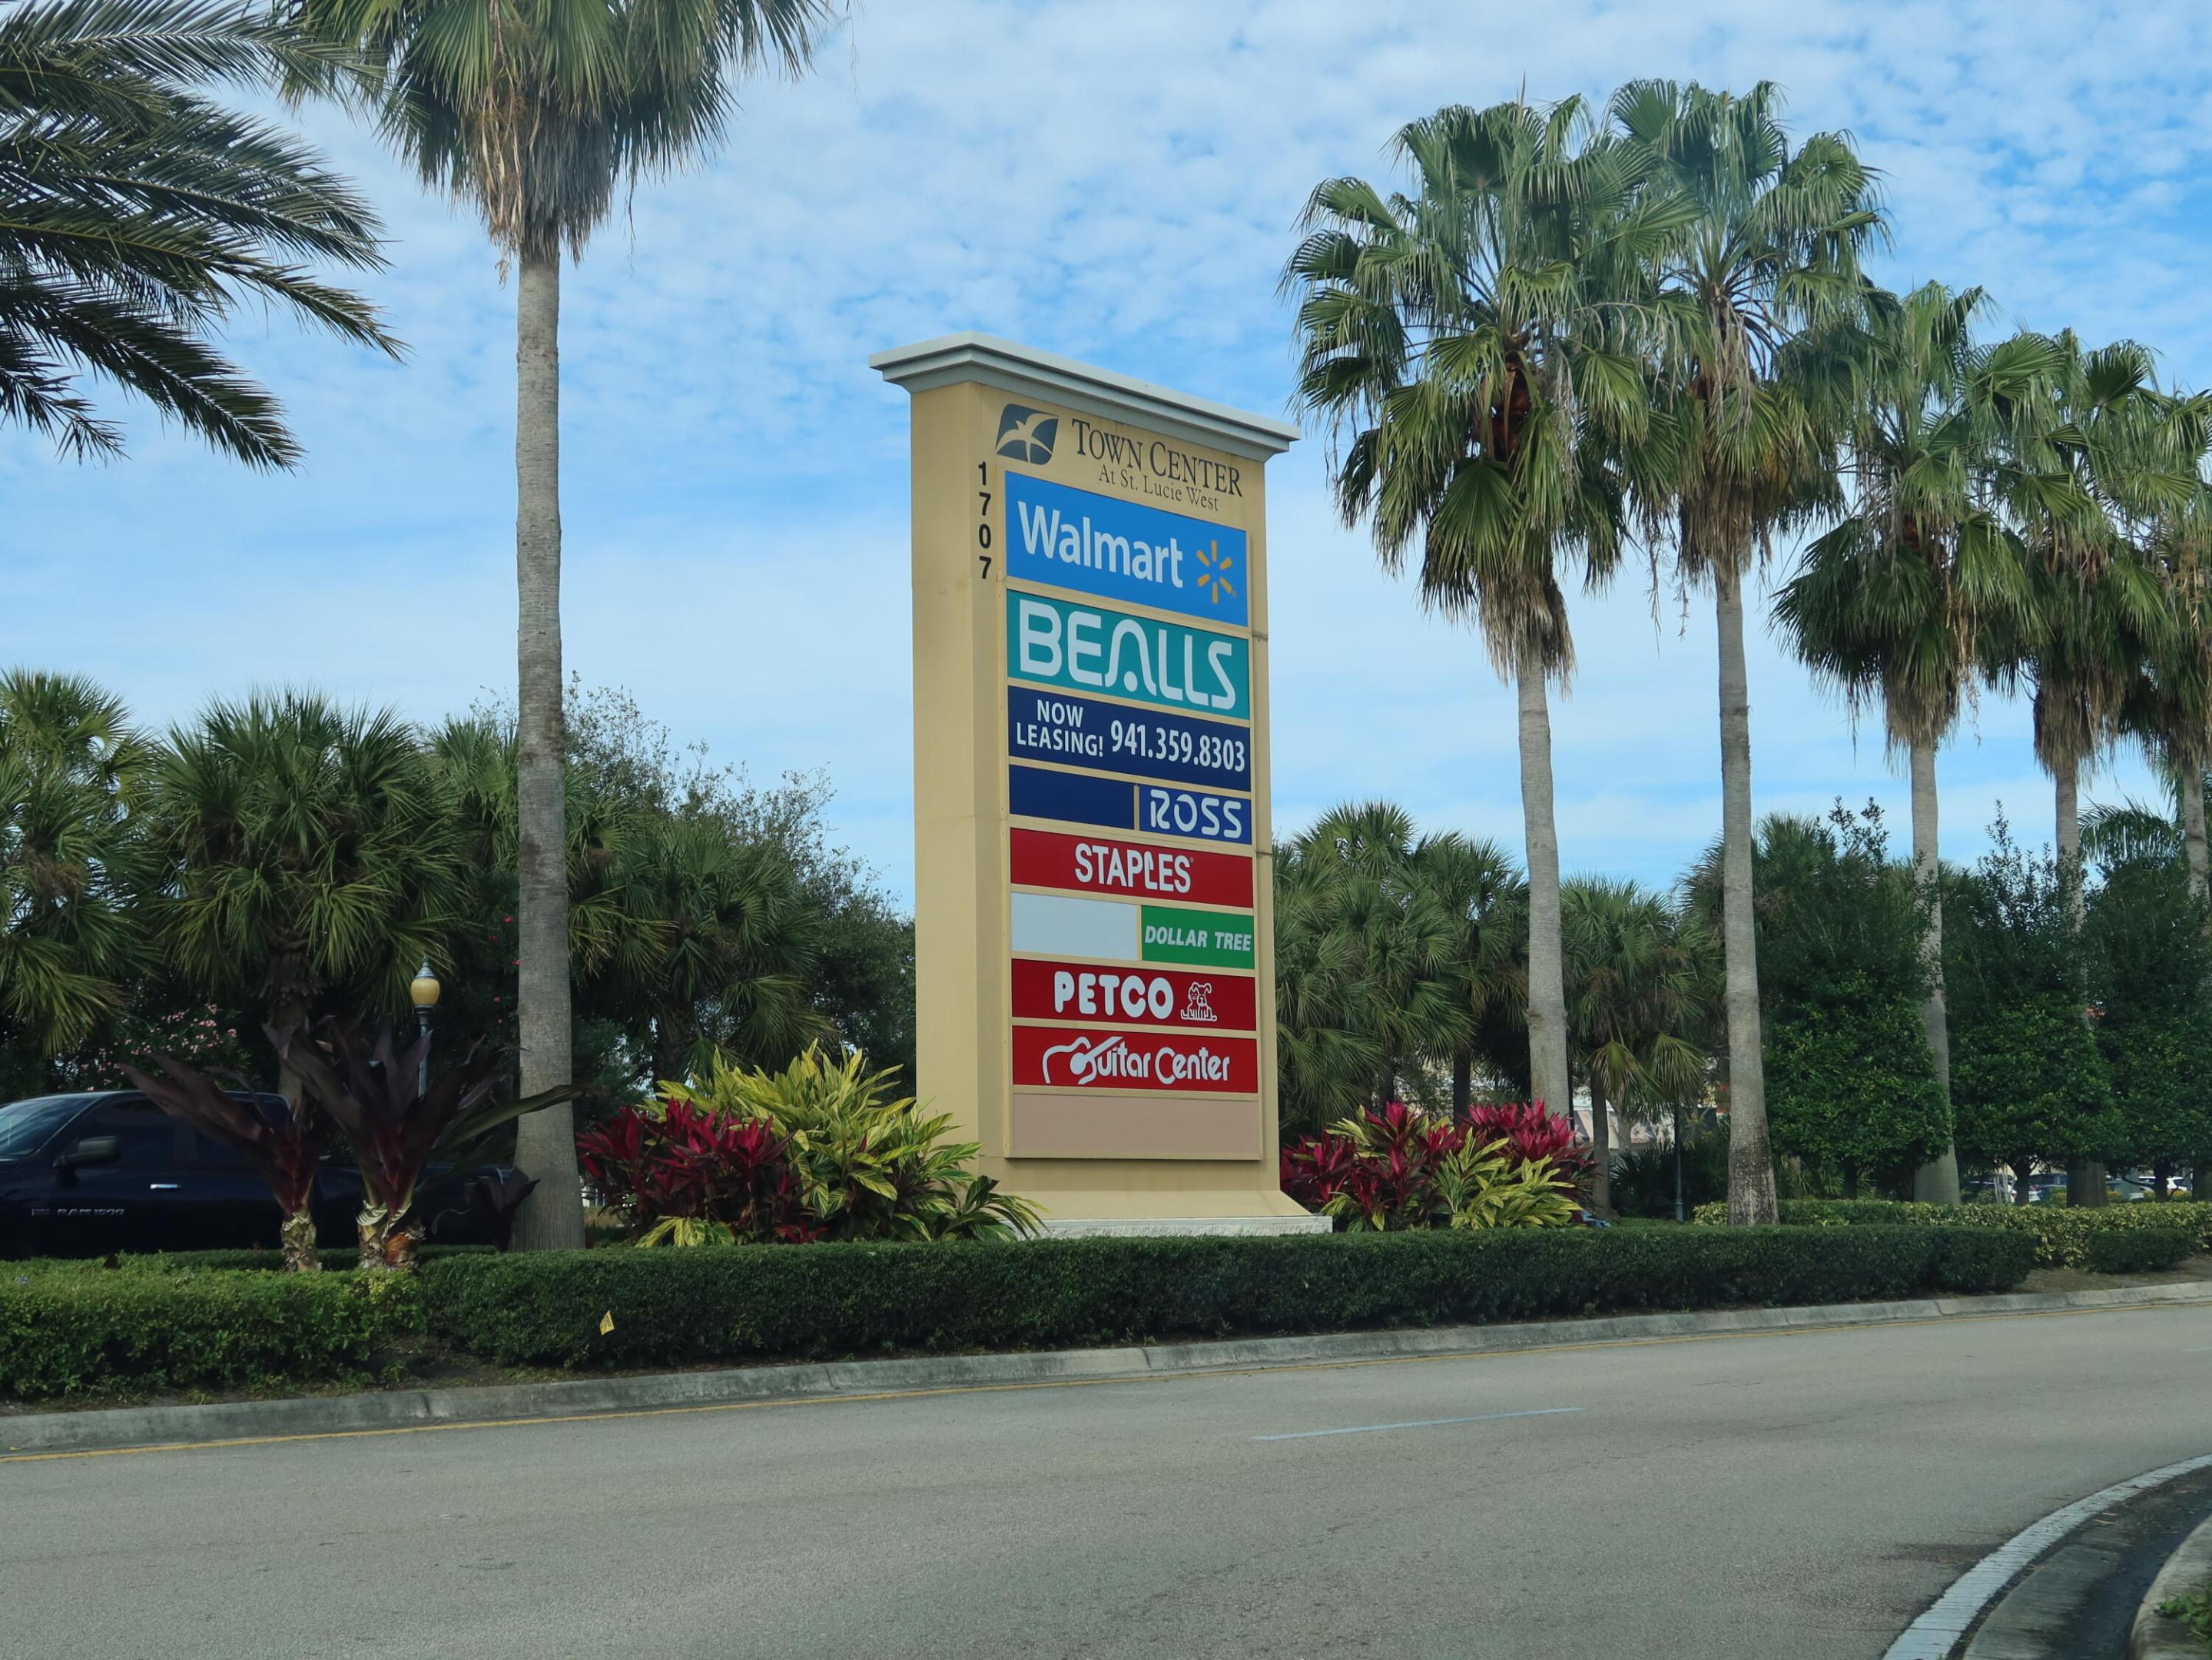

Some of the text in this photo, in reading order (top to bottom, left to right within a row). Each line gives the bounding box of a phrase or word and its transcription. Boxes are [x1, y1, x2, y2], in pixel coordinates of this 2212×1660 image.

[1099, 464, 1219, 511] At St. Lucie West
[978, 461, 992, 579] 1707
[1017, 501, 1183, 588] Walmart
[1020, 599, 1236, 710] BEALLS
[1037, 699, 1083, 728] NOW
[1016, 722, 1104, 757] LEASING!
[1111, 720, 1245, 772] 941.359.8303
[1150, 788, 1242, 839] ROSS
[1076, 843, 1191, 893] STAPLES
[1145, 925, 1252, 951] DOLLAR TREE
[1054, 971, 1174, 1020] PETCO
[1042, 1036, 1230, 1085] Guitar Center
